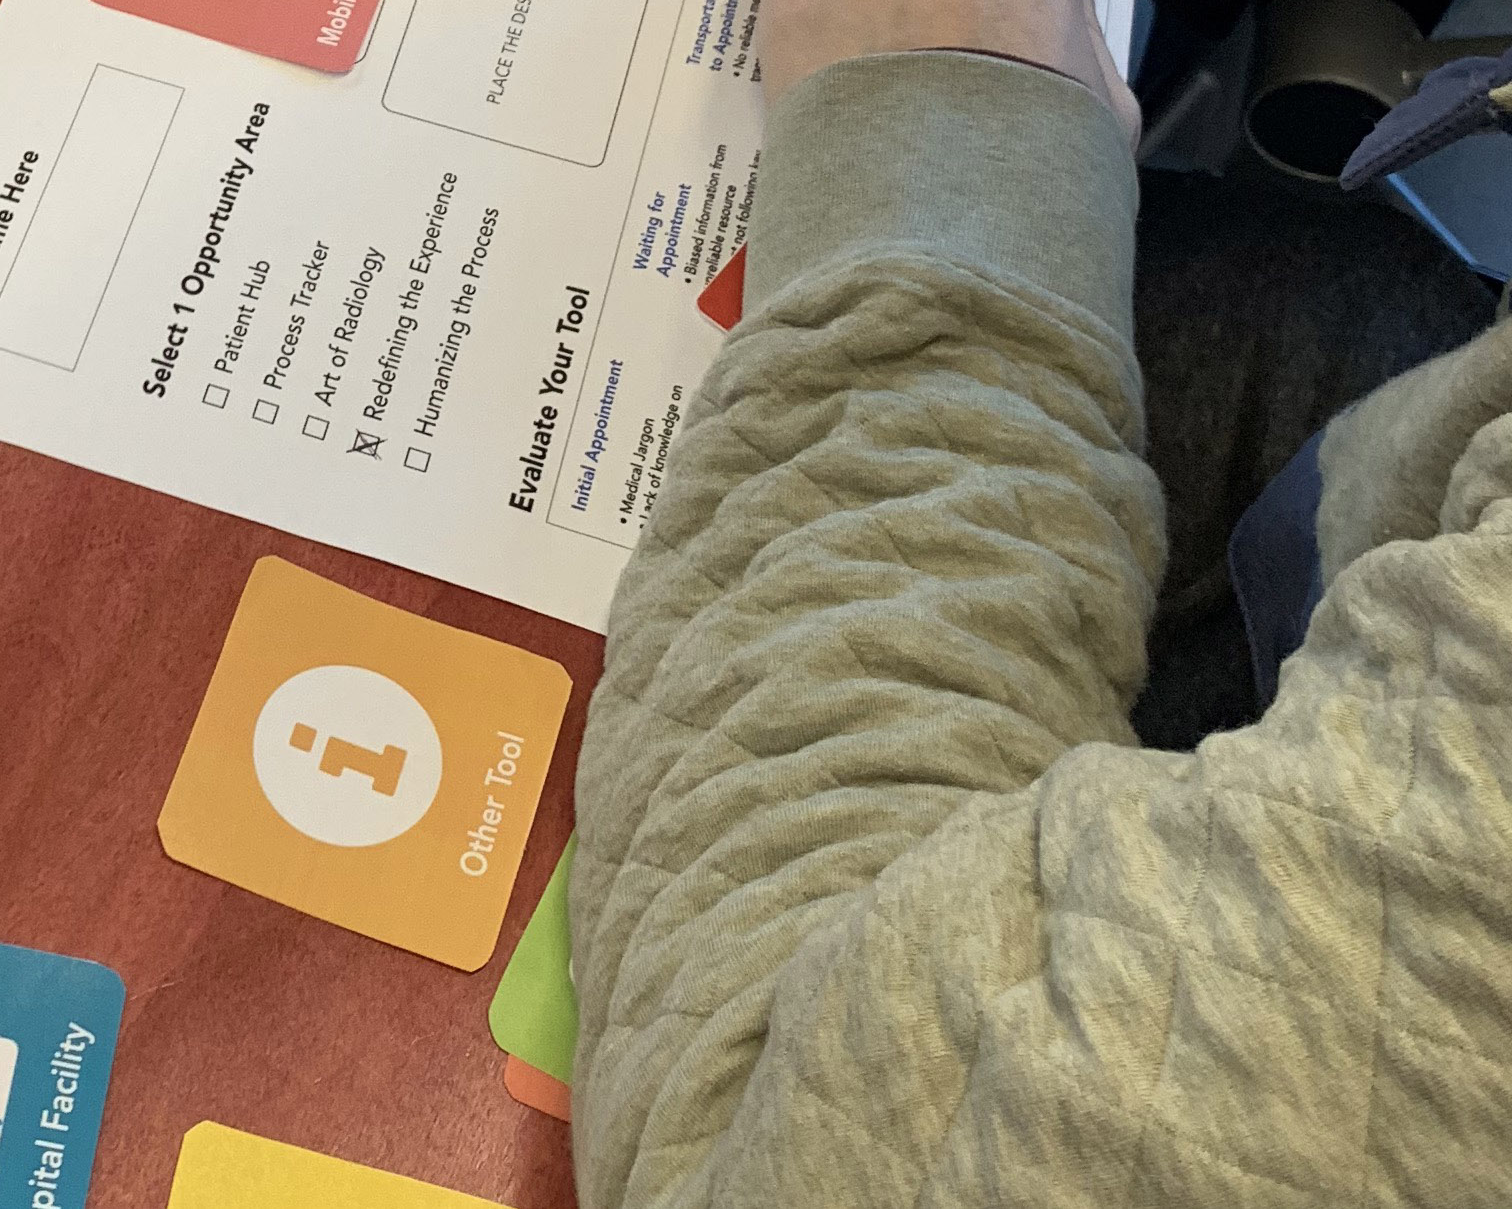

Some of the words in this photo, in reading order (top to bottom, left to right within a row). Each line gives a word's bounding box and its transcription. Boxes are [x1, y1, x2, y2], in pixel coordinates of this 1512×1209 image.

[486, 56, 513, 106] PLACE
[501, 25, 523, 54] THE
[235, 103, 271, 154] Area
[713, 143, 727, 171] from
[0, 151, 39, 203] Here
[647, 190, 666, 214] for
[692, 171, 720, 236] information
[181, 156, 255, 296] Opportunity
[409, 173, 457, 274] Experience
[461, 208, 499, 288] Process
[632, 214, 665, 270] Waiting
[656, 183, 692, 279] Appointment
[684, 236, 707, 276] Biased
[173, 303, 195, 314] 1
[214, 304, 256, 374] Patient
[244, 261, 270, 298] Hub
[263, 315, 306, 391] Process
[290, 240, 329, 307] Tracker
[333, 246, 386, 342] Radiology
[398, 278, 424, 322] the
[451, 284, 476, 327] the
[556, 285, 591, 335] Tool
[143, 323, 188, 398] Select
[314, 372, 341, 407] Art
[328, 343, 349, 368] of
[364, 319, 418, 422] Redefining
[413, 325, 471, 438] Humanizing
[539, 342, 575, 396] Your
[509, 401, 559, 513] Evaluate
[570, 465, 597, 512] Initial
[585, 359, 625, 463] Appointment
[619, 460, 644, 515] Medical
[633, 417, 655, 459] Jargon
[459, 794, 506, 877] Other
[485, 730, 526, 787] Tool
[40, 1021, 96, 1132] Facility
[28, 1139, 66, 1209] pital
